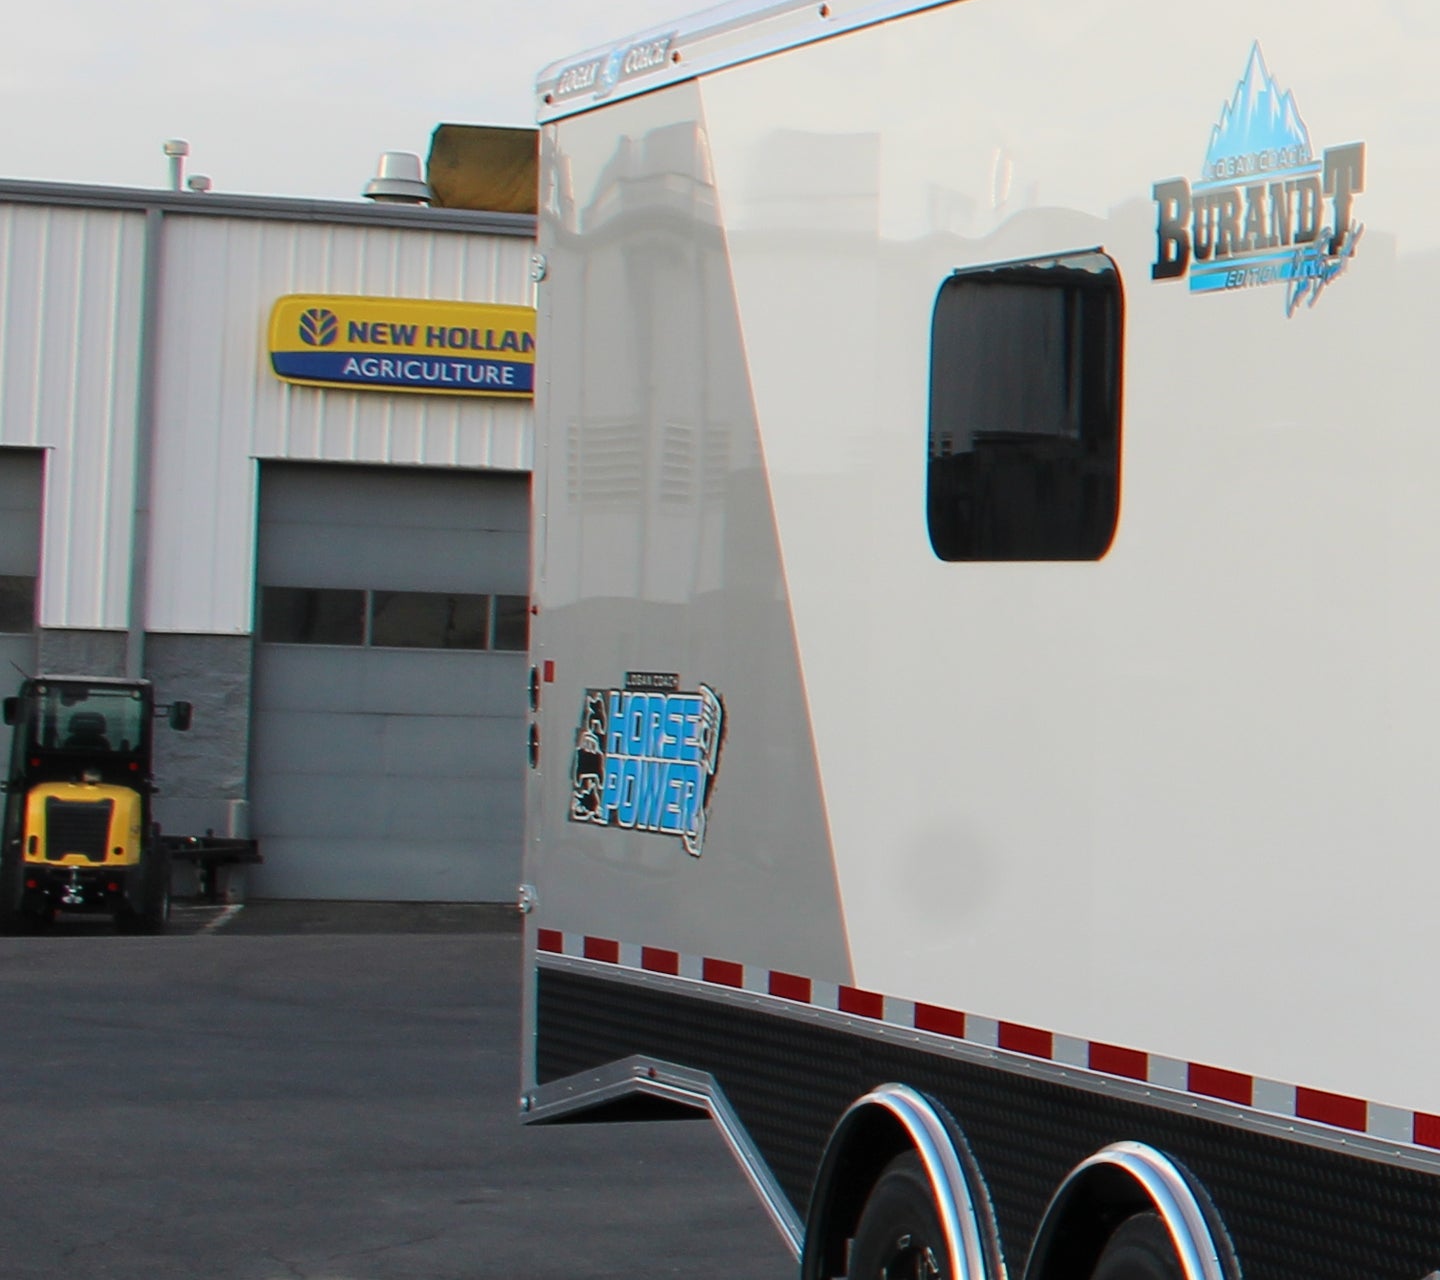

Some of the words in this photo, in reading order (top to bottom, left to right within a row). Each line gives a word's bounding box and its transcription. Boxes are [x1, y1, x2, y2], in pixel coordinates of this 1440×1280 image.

[1151, 141, 1365, 281] BURANDT
[1225, 265, 1279, 289] EDITION
[348, 320, 418, 347] NEW
[344, 357, 514, 386] AGRICULTURE
[606, 690, 704, 763] HORSE
[601, 753, 704, 837] POWER
